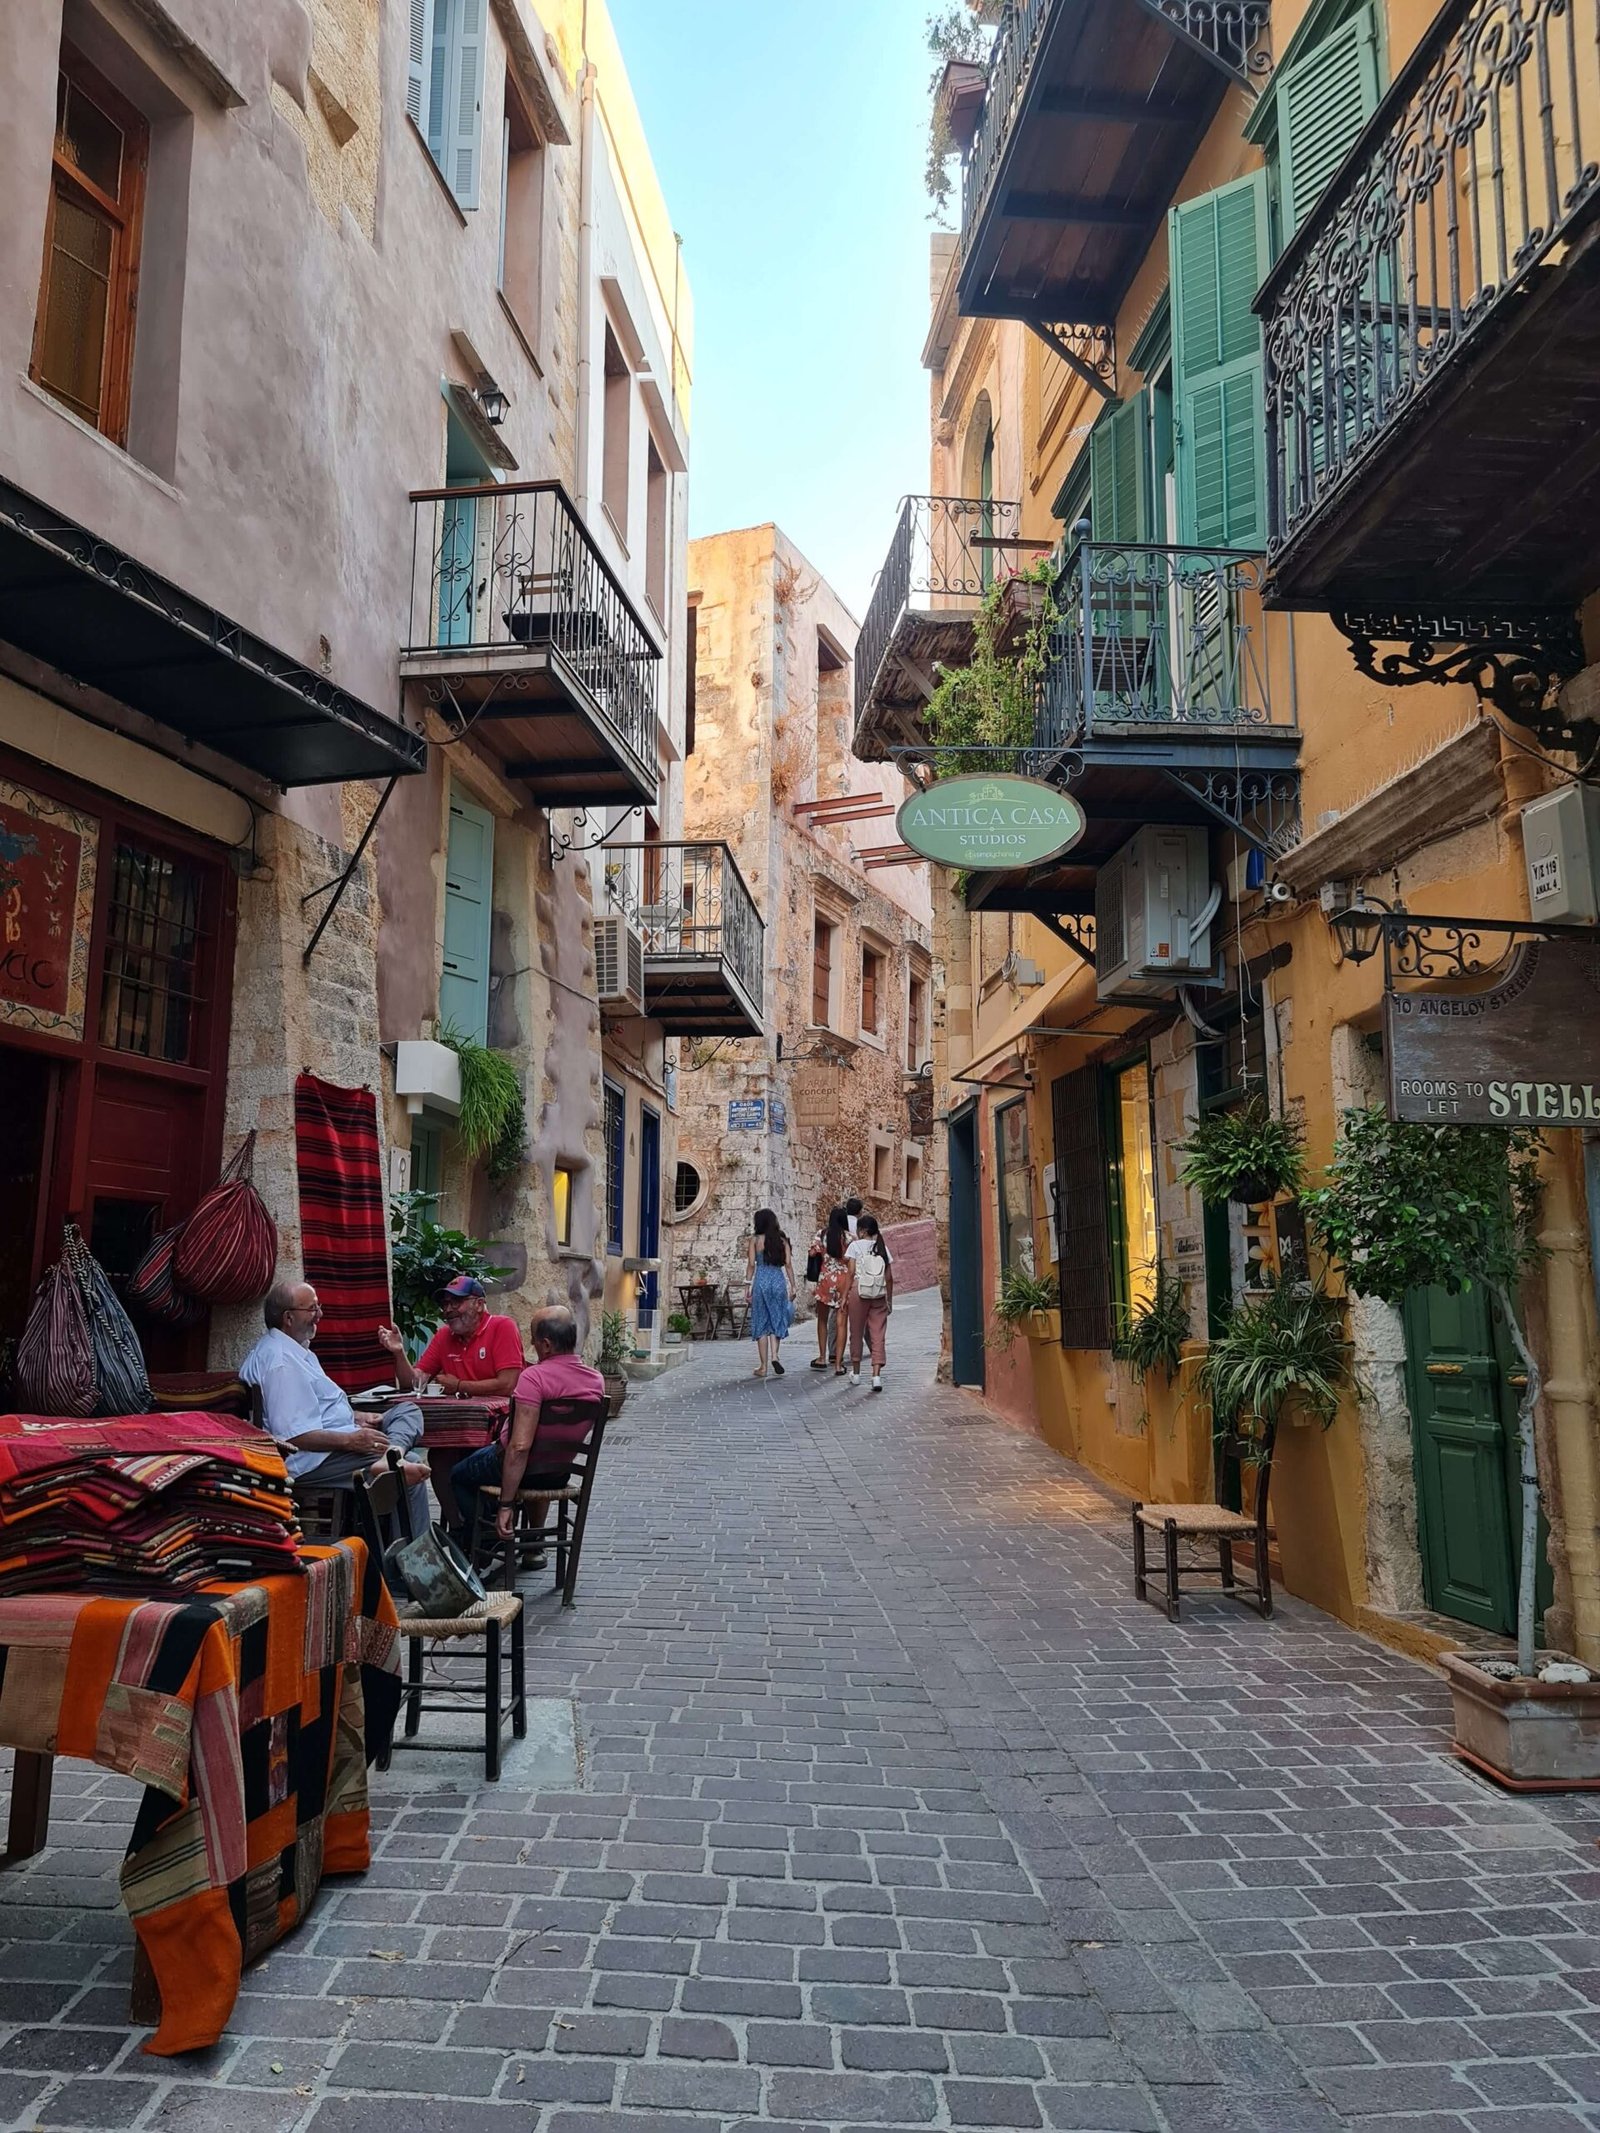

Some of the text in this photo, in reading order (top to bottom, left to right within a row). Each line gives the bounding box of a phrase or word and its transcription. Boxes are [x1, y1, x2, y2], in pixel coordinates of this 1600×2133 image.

[911, 807, 1071, 826] ANTICA CASA
[959, 834, 1026, 845] STUDIOS
[1546, 860, 1557, 875] 119
[1418, 998, 1486, 1016] ANGELOY
[800, 1087, 837, 1097] concept
[1400, 1080, 1484, 1097] ROOMS TO
[1427, 1101, 1459, 1115] LET
